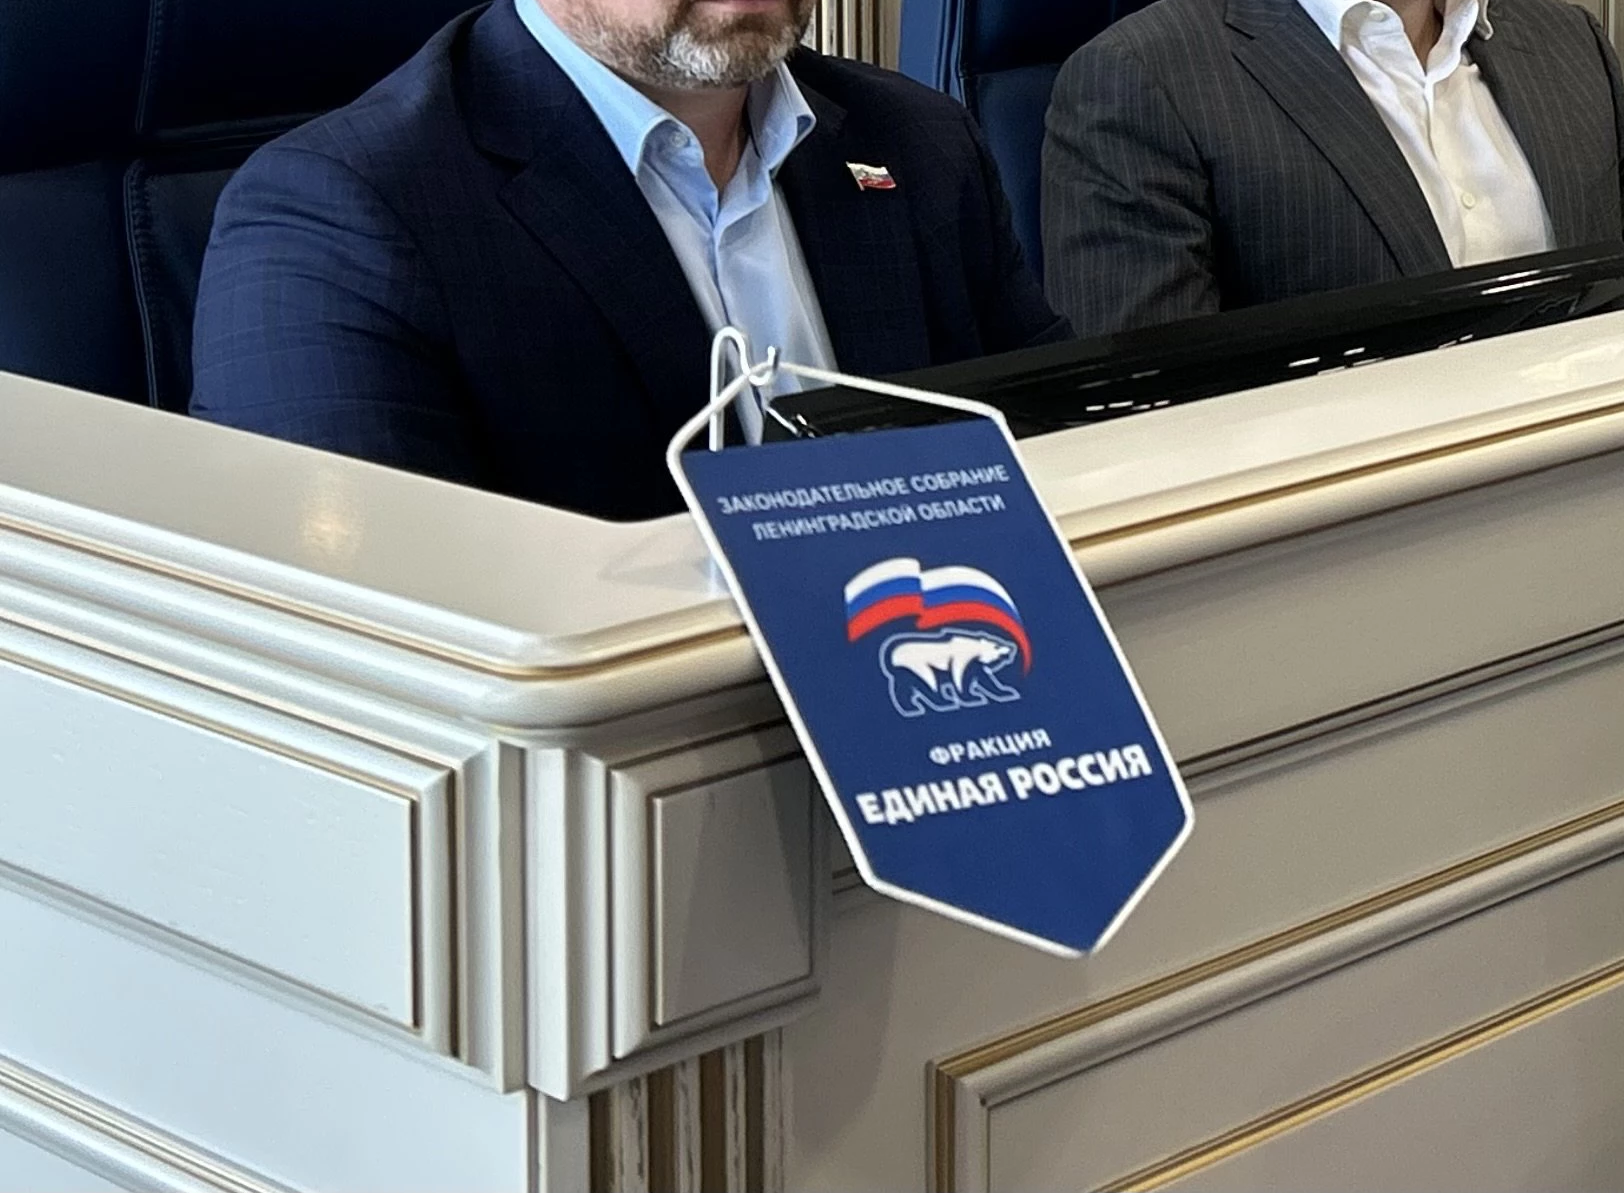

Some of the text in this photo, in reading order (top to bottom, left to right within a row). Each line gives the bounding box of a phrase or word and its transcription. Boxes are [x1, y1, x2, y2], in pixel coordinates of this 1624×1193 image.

[716, 464, 1010, 514] ЗАКОНОДАТЕЛЬНОЕ СОБРАНИЕ
[752, 494, 1006, 541] ЛЕНИНГРАДСКОЙ ОБЛАСТИ
[929, 728, 1052, 765] ФРАКЦИЯ
[855, 743, 1152, 825] ЕДИНАЯ РОССИЯ
